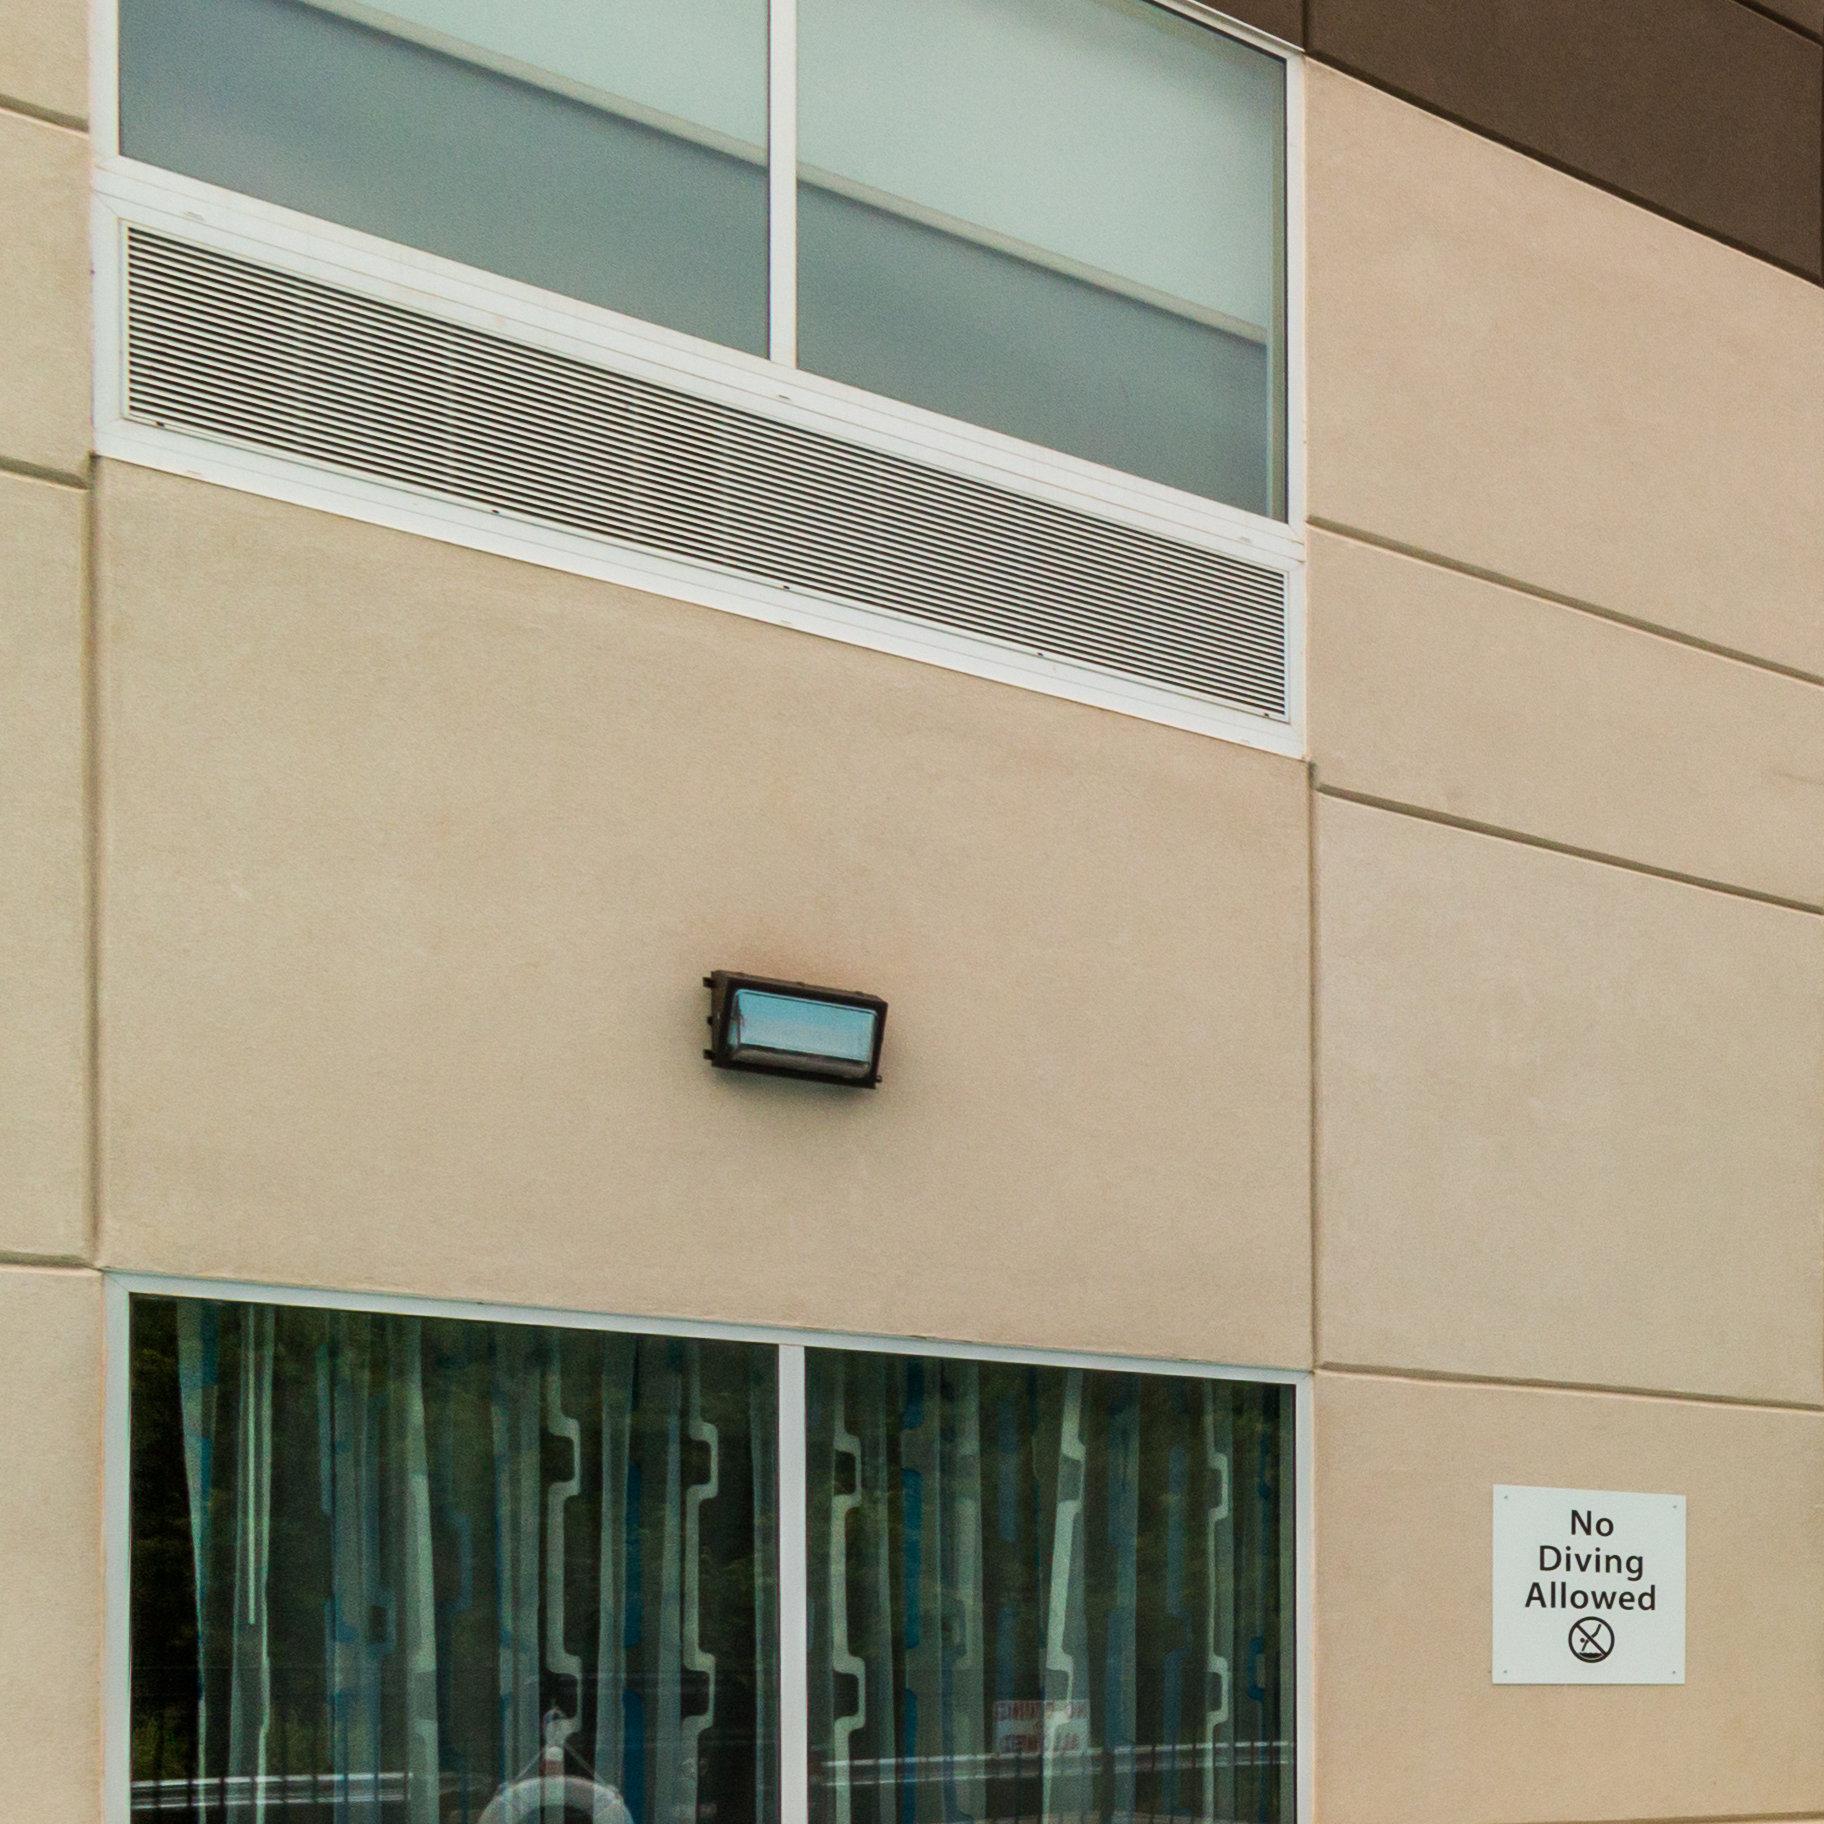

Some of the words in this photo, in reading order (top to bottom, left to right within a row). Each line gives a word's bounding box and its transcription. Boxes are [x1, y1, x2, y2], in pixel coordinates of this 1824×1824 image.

[1570, 1509, 1615, 1537] No
[1538, 1545, 1645, 1582] Diving
[1524, 1581, 1657, 1611] Allowed
